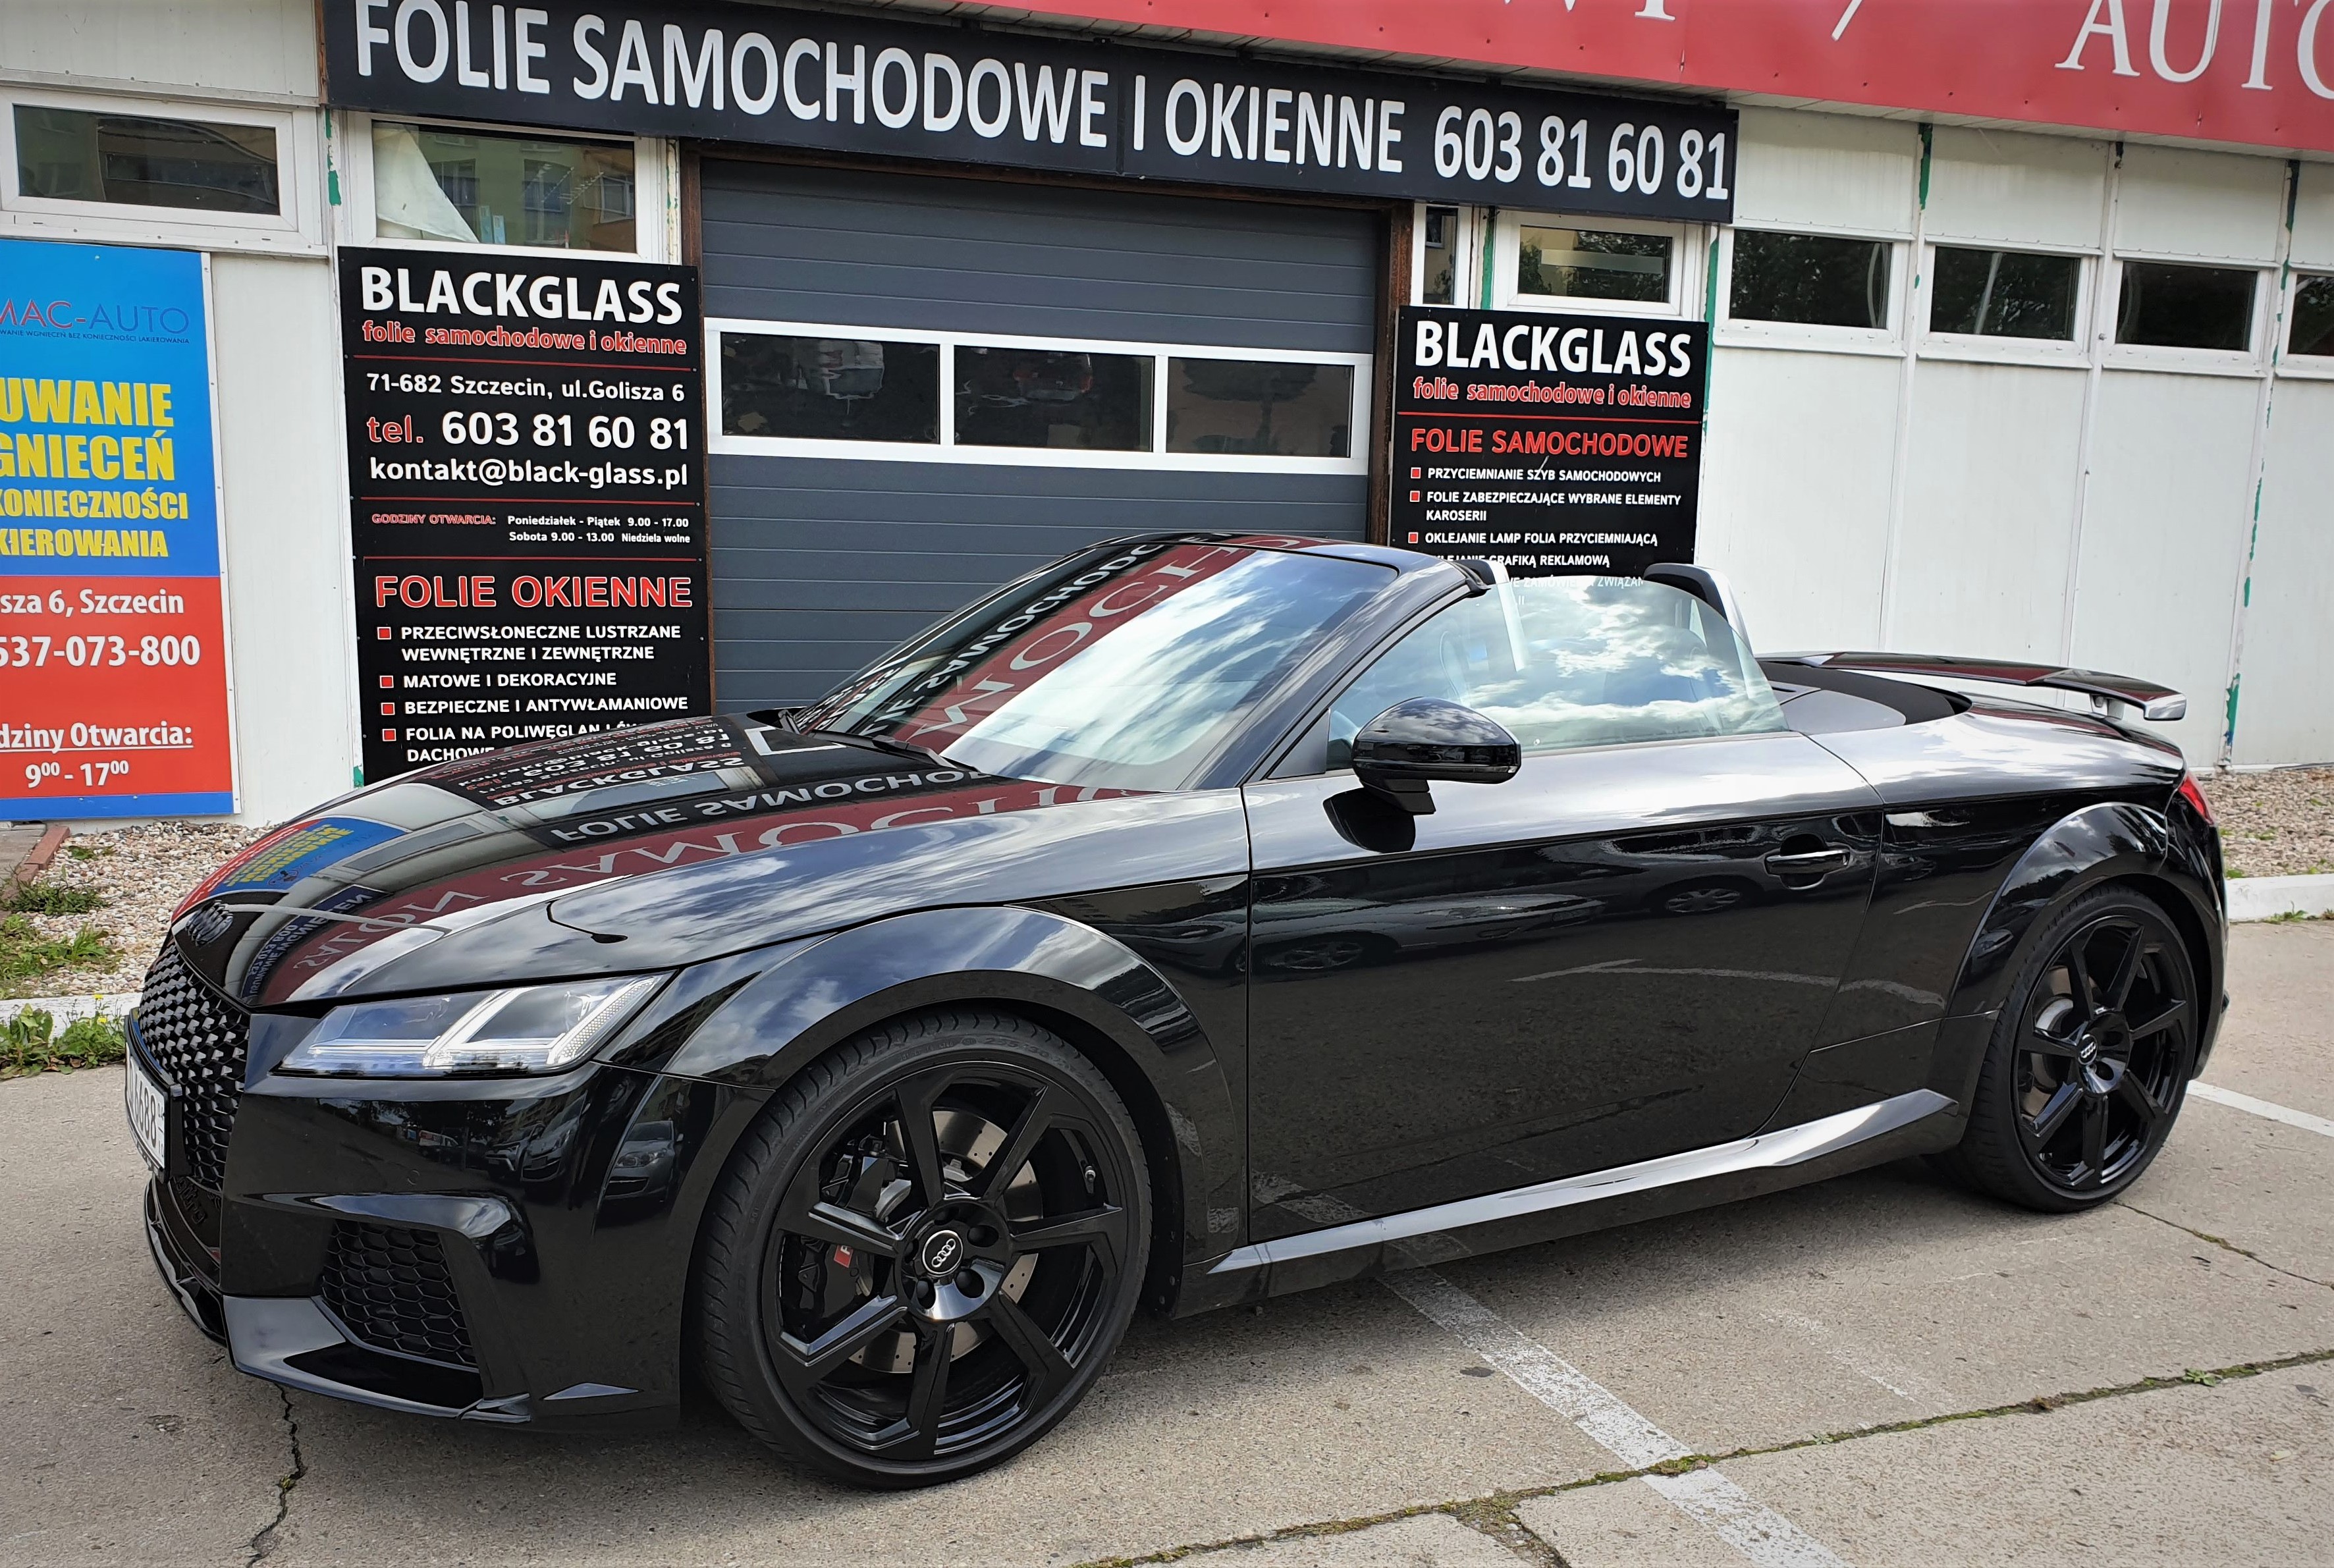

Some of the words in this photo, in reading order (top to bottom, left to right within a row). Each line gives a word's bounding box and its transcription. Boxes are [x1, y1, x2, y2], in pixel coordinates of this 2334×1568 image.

[356, 0, 550, 94] FOLIE
[572, 14, 1108, 148] SAMOCHODOWE
[1133, 74, 1145, 151] I
[1165, 79, 1405, 173] OKIENNE
[1434, 105, 1522, 183] 603
[1537, 115, 1590, 189] 81
[1608, 122, 1664, 195] 60
[1677, 129, 1728, 200] 81
[360, 266, 682, 325] BLACKGLASS
[362, 320, 416, 342] folie
[425, 325, 585, 350] samochodowe
[589, 329, 597, 350] i
[601, 332, 687, 354] okienne
[1415, 320, 1692, 377] BLACKGLASS
[367, 373, 442, 393] 71-682
[450, 374, 553, 400] Szczecin,
[562, 379, 664, 401] ul.Golisza
[672, 384, 685, 402] 6
[1413, 377, 1459, 400] folie
[1467, 381, 1605, 405] samochodowe
[1608, 384, 1614, 405] i
[1617, 385, 1692, 409] okienne
[367, 415, 424, 443] tel.
[442, 411, 520, 446] 603
[532, 414, 572, 447] 81
[589, 416, 636, 448] 60
[649, 418, 688, 450] 81
[1411, 428, 1483, 453] FOLIE
[1492, 430, 1689, 458] SAMOCHODOWE
[370, 456, 688, 490] kontakt@black-glass.pl
[1428, 468, 1524, 480] PRZYCIEMNIANIE
[1527, 470, 1556, 481] SZYB
[1559, 470, 1661, 483] SAMOCHODOWYCH
[0, 487, 188, 520] ONIECZNOŚCI
[1426, 491, 1459, 503] FOLIE
[1463, 492, 1565, 506] ZABEZPIECZAJĄCE
[1568, 493, 1622, 504] WYBRANE
[1625, 494, 1681, 506] ELEMENTY
[371, 514, 426, 525] GODZINY
[507, 515, 576, 526] Poniedziałek
[587, 516, 620, 528] Piątek
[628, 516, 651, 527] 9.00
[662, 517, 689, 527] 17.00
[1426, 510, 1487, 522] KAROSERII
[509, 531, 547, 542] Sobota
[551, 532, 575, 542] 9.00
[586, 532, 614, 543] 13.00
[621, 532, 662, 543] Niedziela
[664, 533, 690, 543] wolne
[1425, 533, 1486, 545] OKLEJANIE
[1490, 533, 1521, 544] LAMP
[1525, 533, 1556, 544] FOLIA
[1560, 533, 1658, 547] PRZYCIEMNIAJĄCĄ
[1540, 554, 1610, 568] REKLAMOWĄ
[0, 594, 42, 614] sza
[49, 589, 74, 618] 6,
[80, 588, 184, 614] Szczecin
[375, 575, 497, 608] FOLIE
[511, 575, 693, 608] OKIENNE
[401, 626, 580, 640] PRZECIWSŁONECZNE
[586, 625, 681, 639] LUSTRZANE
[402, 647, 526, 664] WEWNĘTRZNE
[531, 648, 536, 660] I
[542, 646, 654, 662] ZEWNĘTRZNE
[404, 674, 481, 688] MATOWE
[487, 674, 491, 687] I
[497, 672, 617, 687] DEKORACYJNE
[404, 699, 510, 715] BEZPIECZNE
[516, 699, 520, 713] I
[526, 697, 688, 712] ANTYWŁAMANIOWE
[70, 720, 192, 747] Otwarcia:
[406, 727, 456, 741] FOLIA
[462, 726, 485, 740] NA
